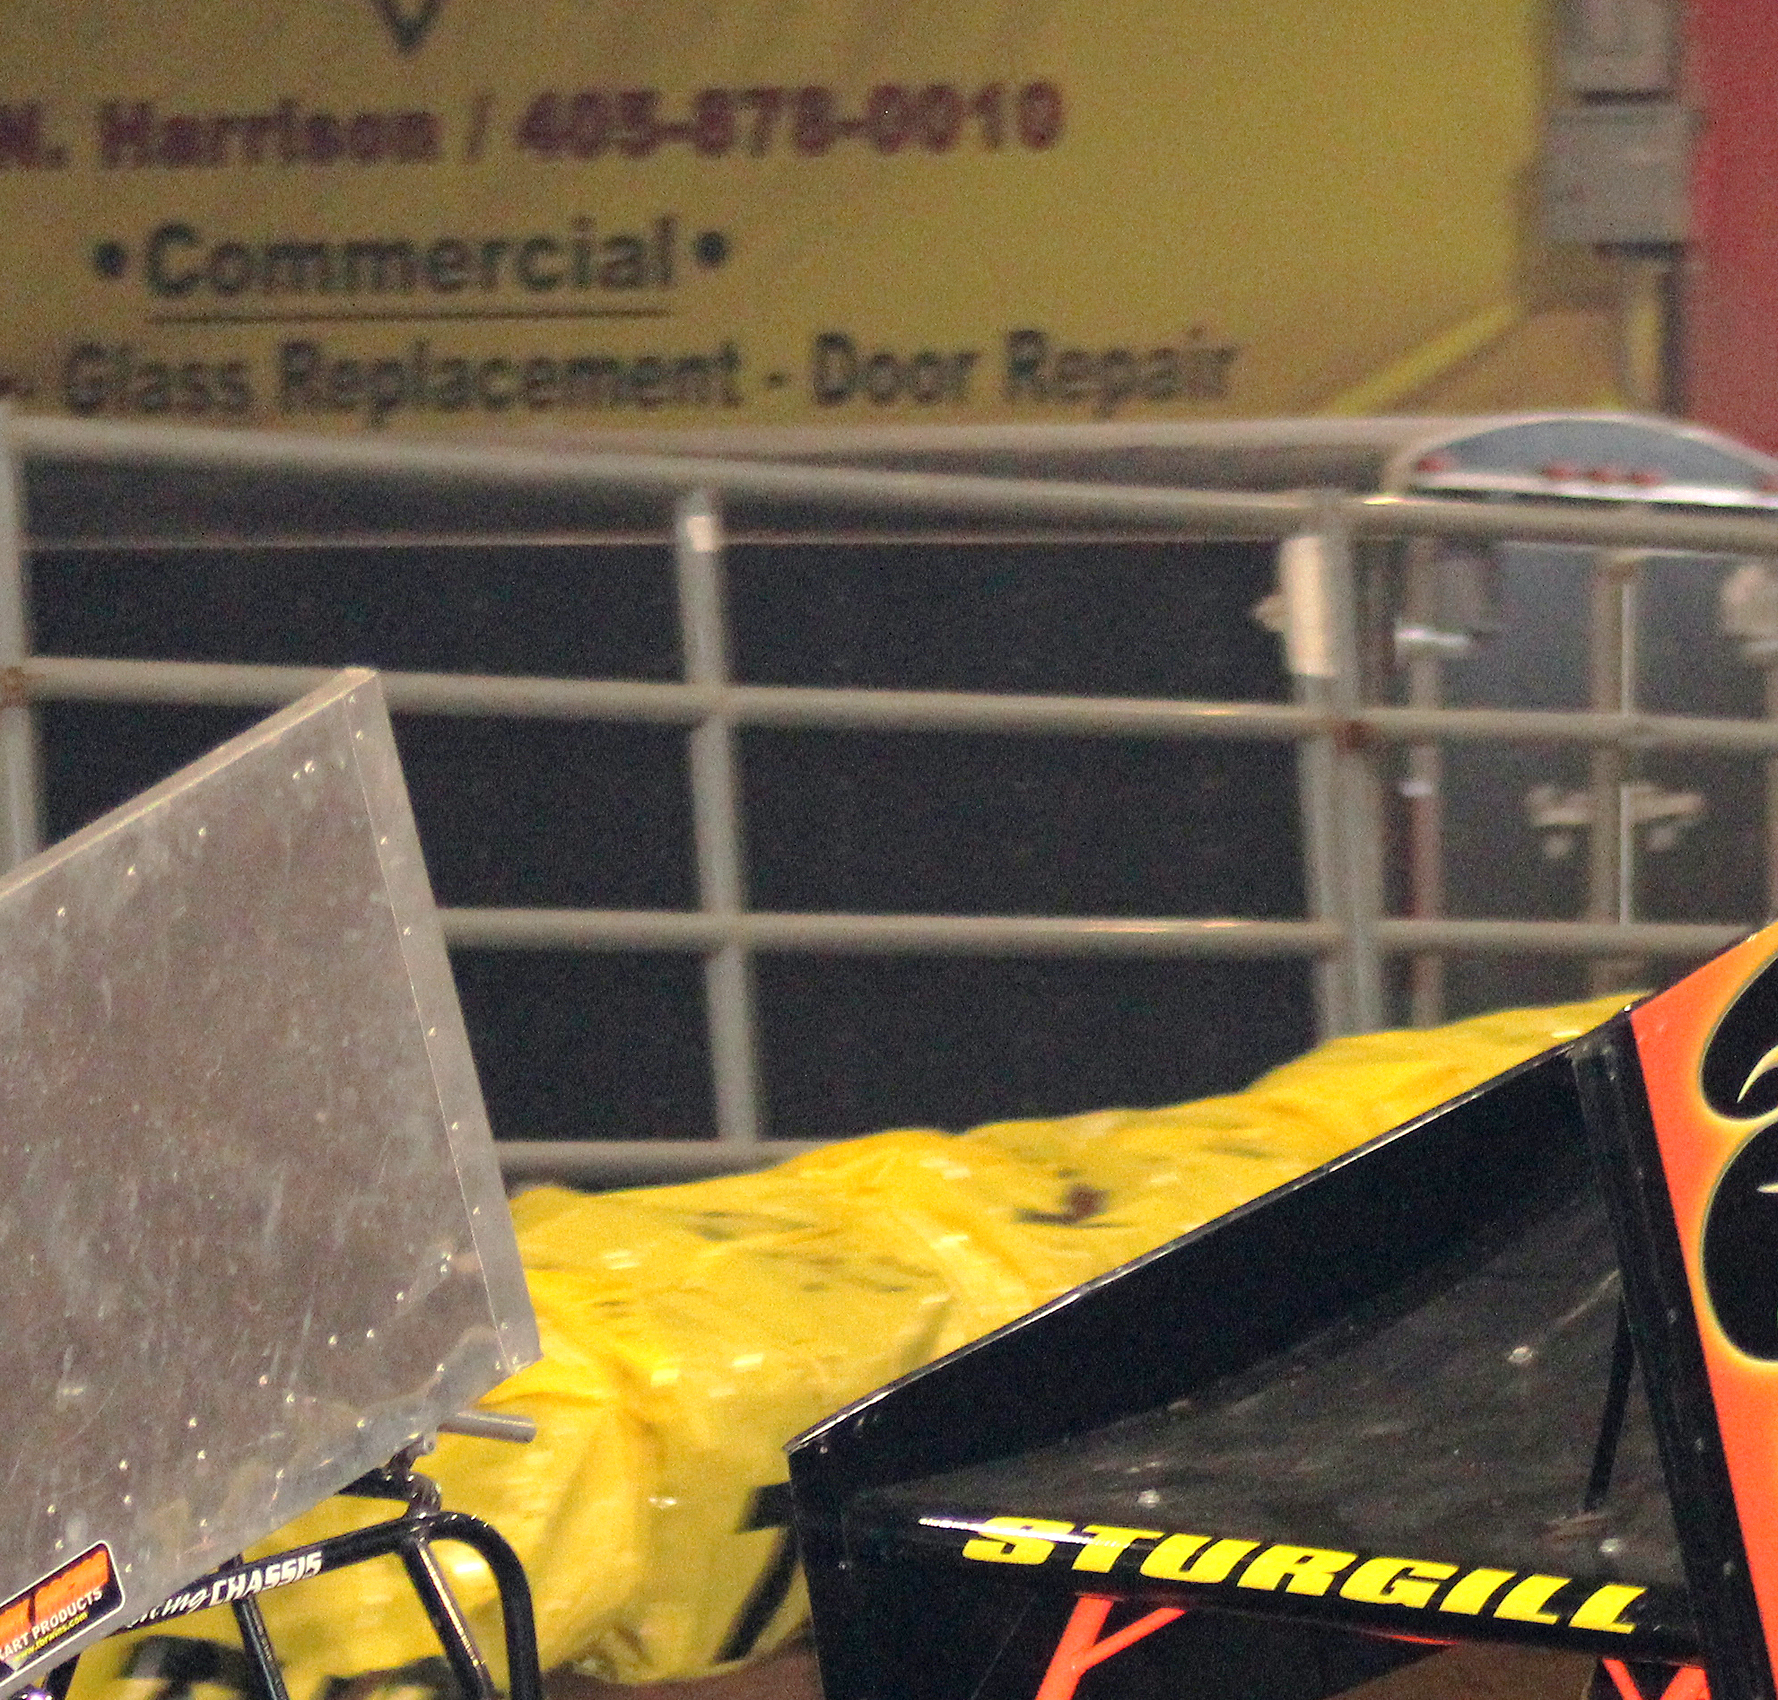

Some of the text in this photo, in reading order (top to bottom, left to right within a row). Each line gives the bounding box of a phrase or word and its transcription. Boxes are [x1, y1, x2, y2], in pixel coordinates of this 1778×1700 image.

[62, 340, 252, 416] Glass
[278, 338, 744, 428] Replacement
[812, 330, 982, 406] Door
[1004, 325, 1240, 420] Repair
[31, 1584, 105, 1640] PRODUCTS
[207, 1549, 324, 1609] CHASSIS
[960, 1515, 1650, 1636] STURGILL
